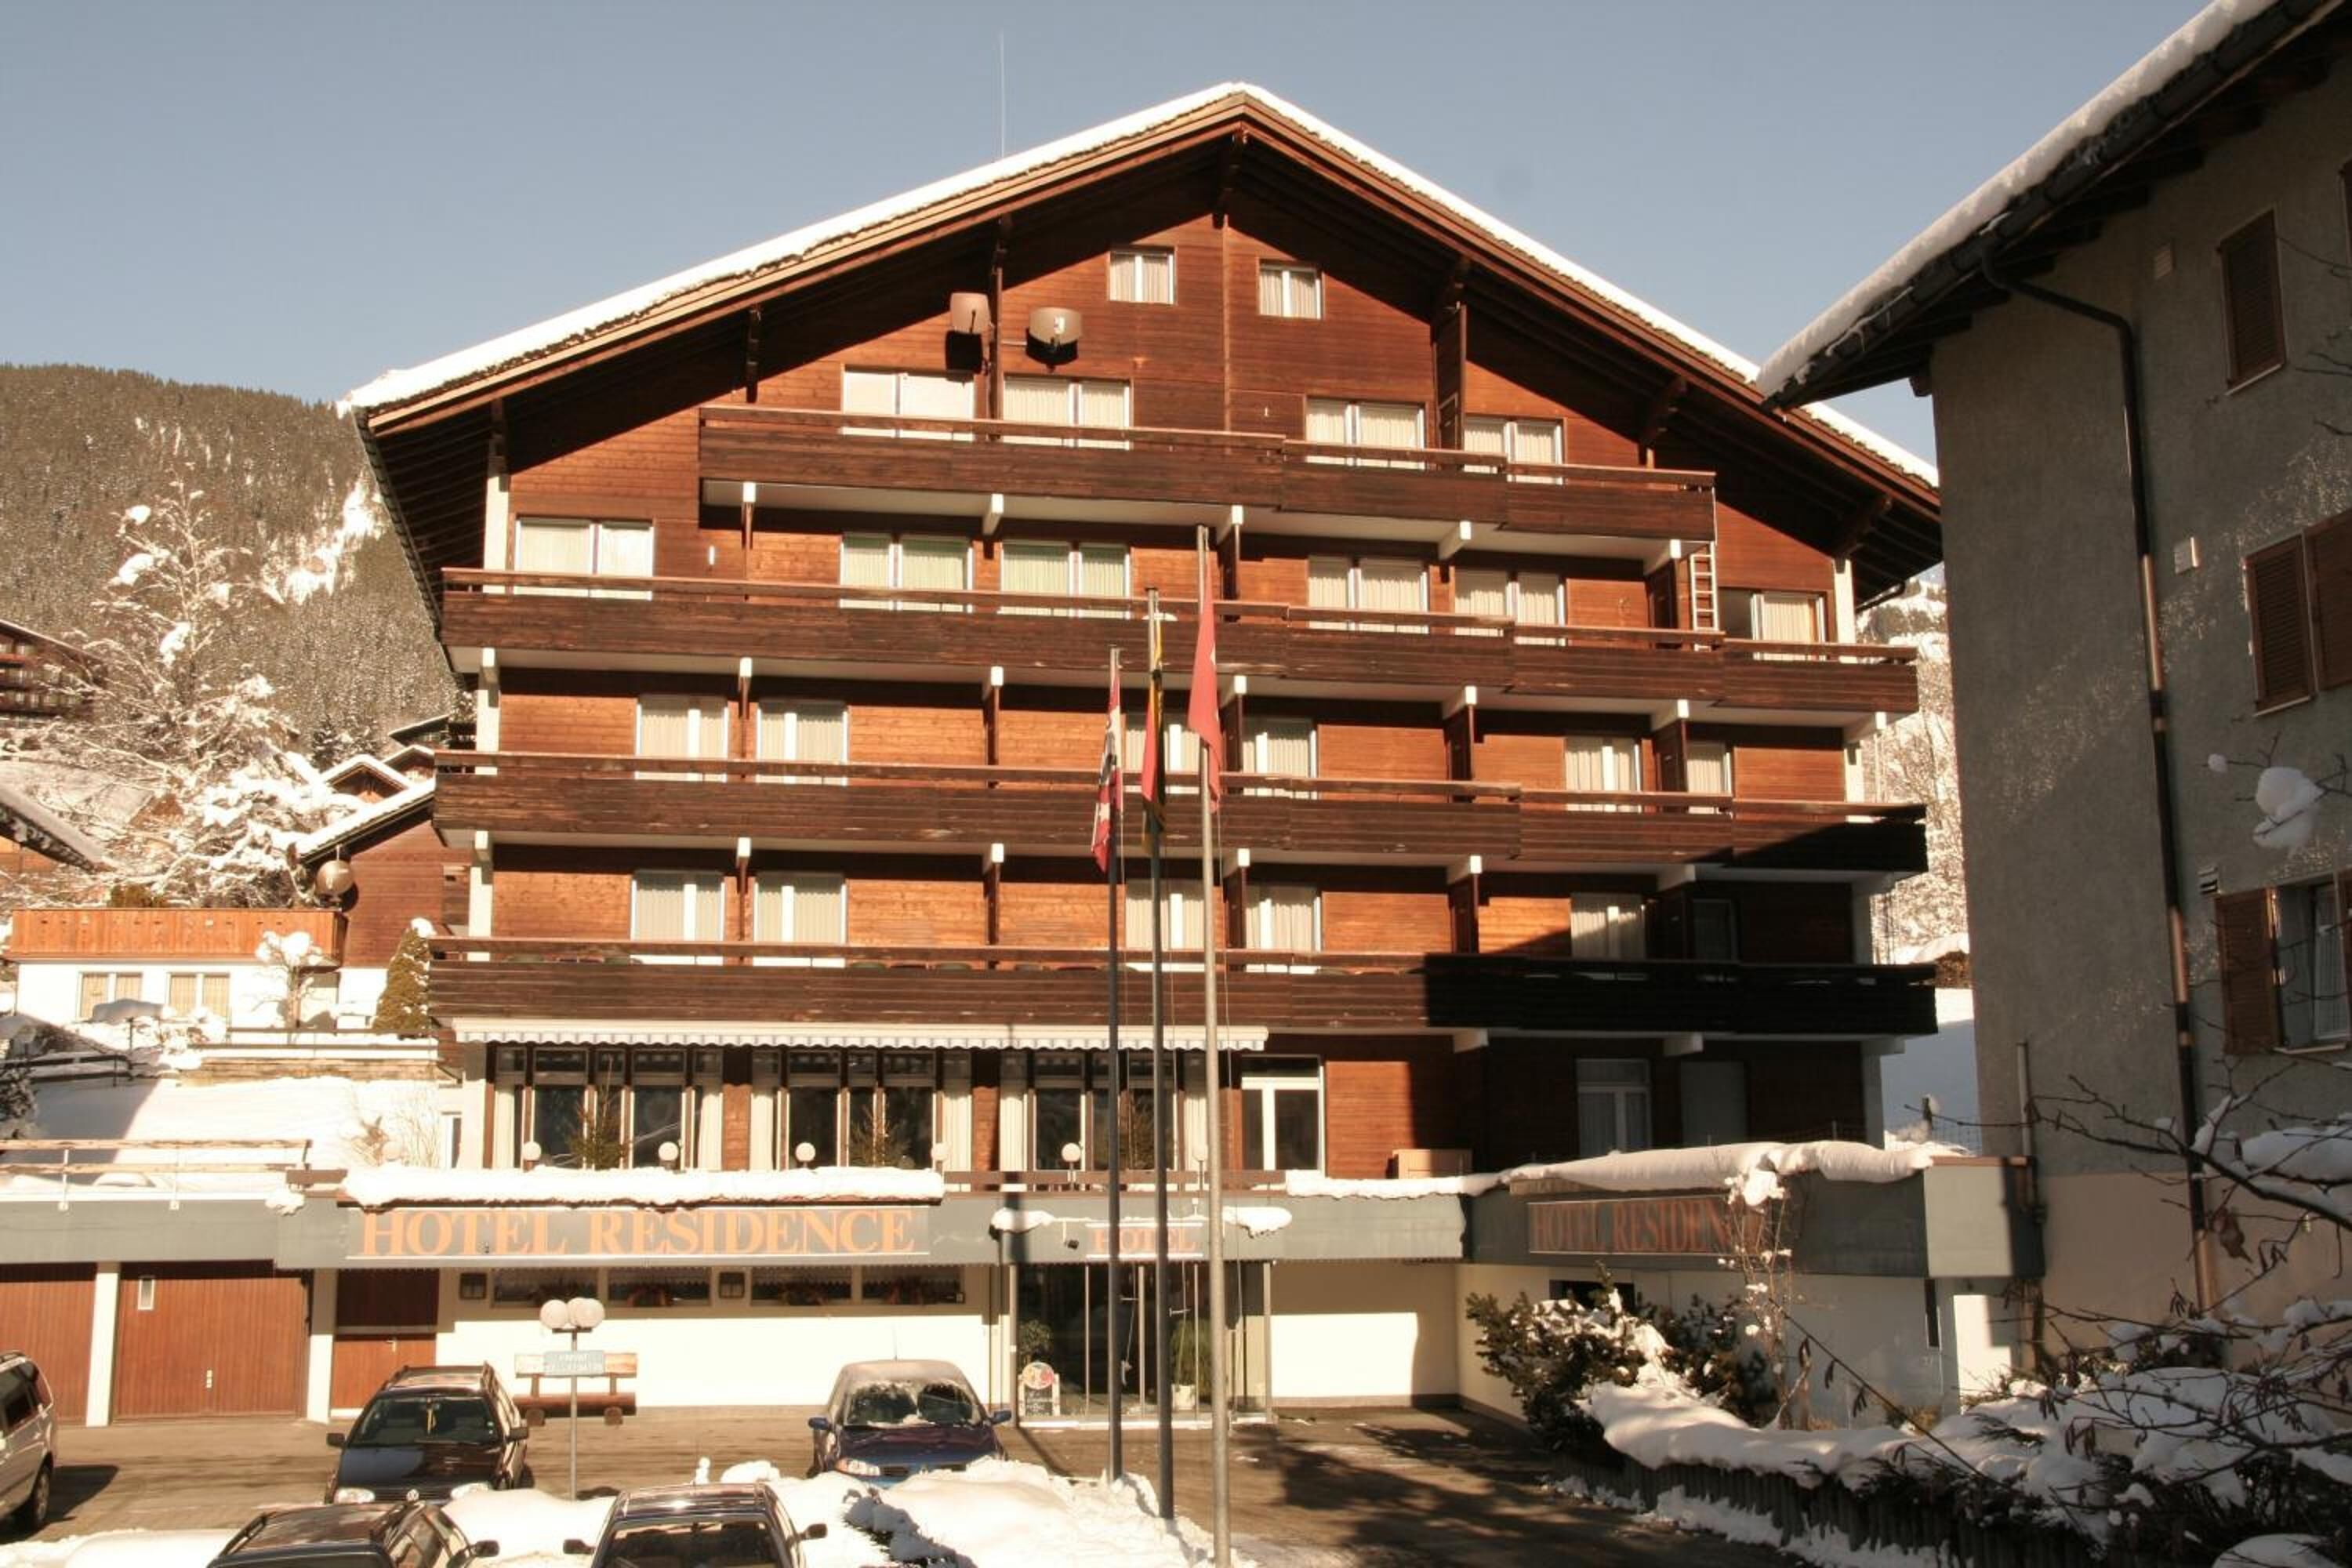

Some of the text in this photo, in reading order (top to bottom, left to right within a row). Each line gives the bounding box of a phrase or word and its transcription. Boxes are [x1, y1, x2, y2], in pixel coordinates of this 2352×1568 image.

[361, 1210, 915, 1254] HOTEL RESIDENCE
[1534, 1202, 1606, 1252] HOTEL
